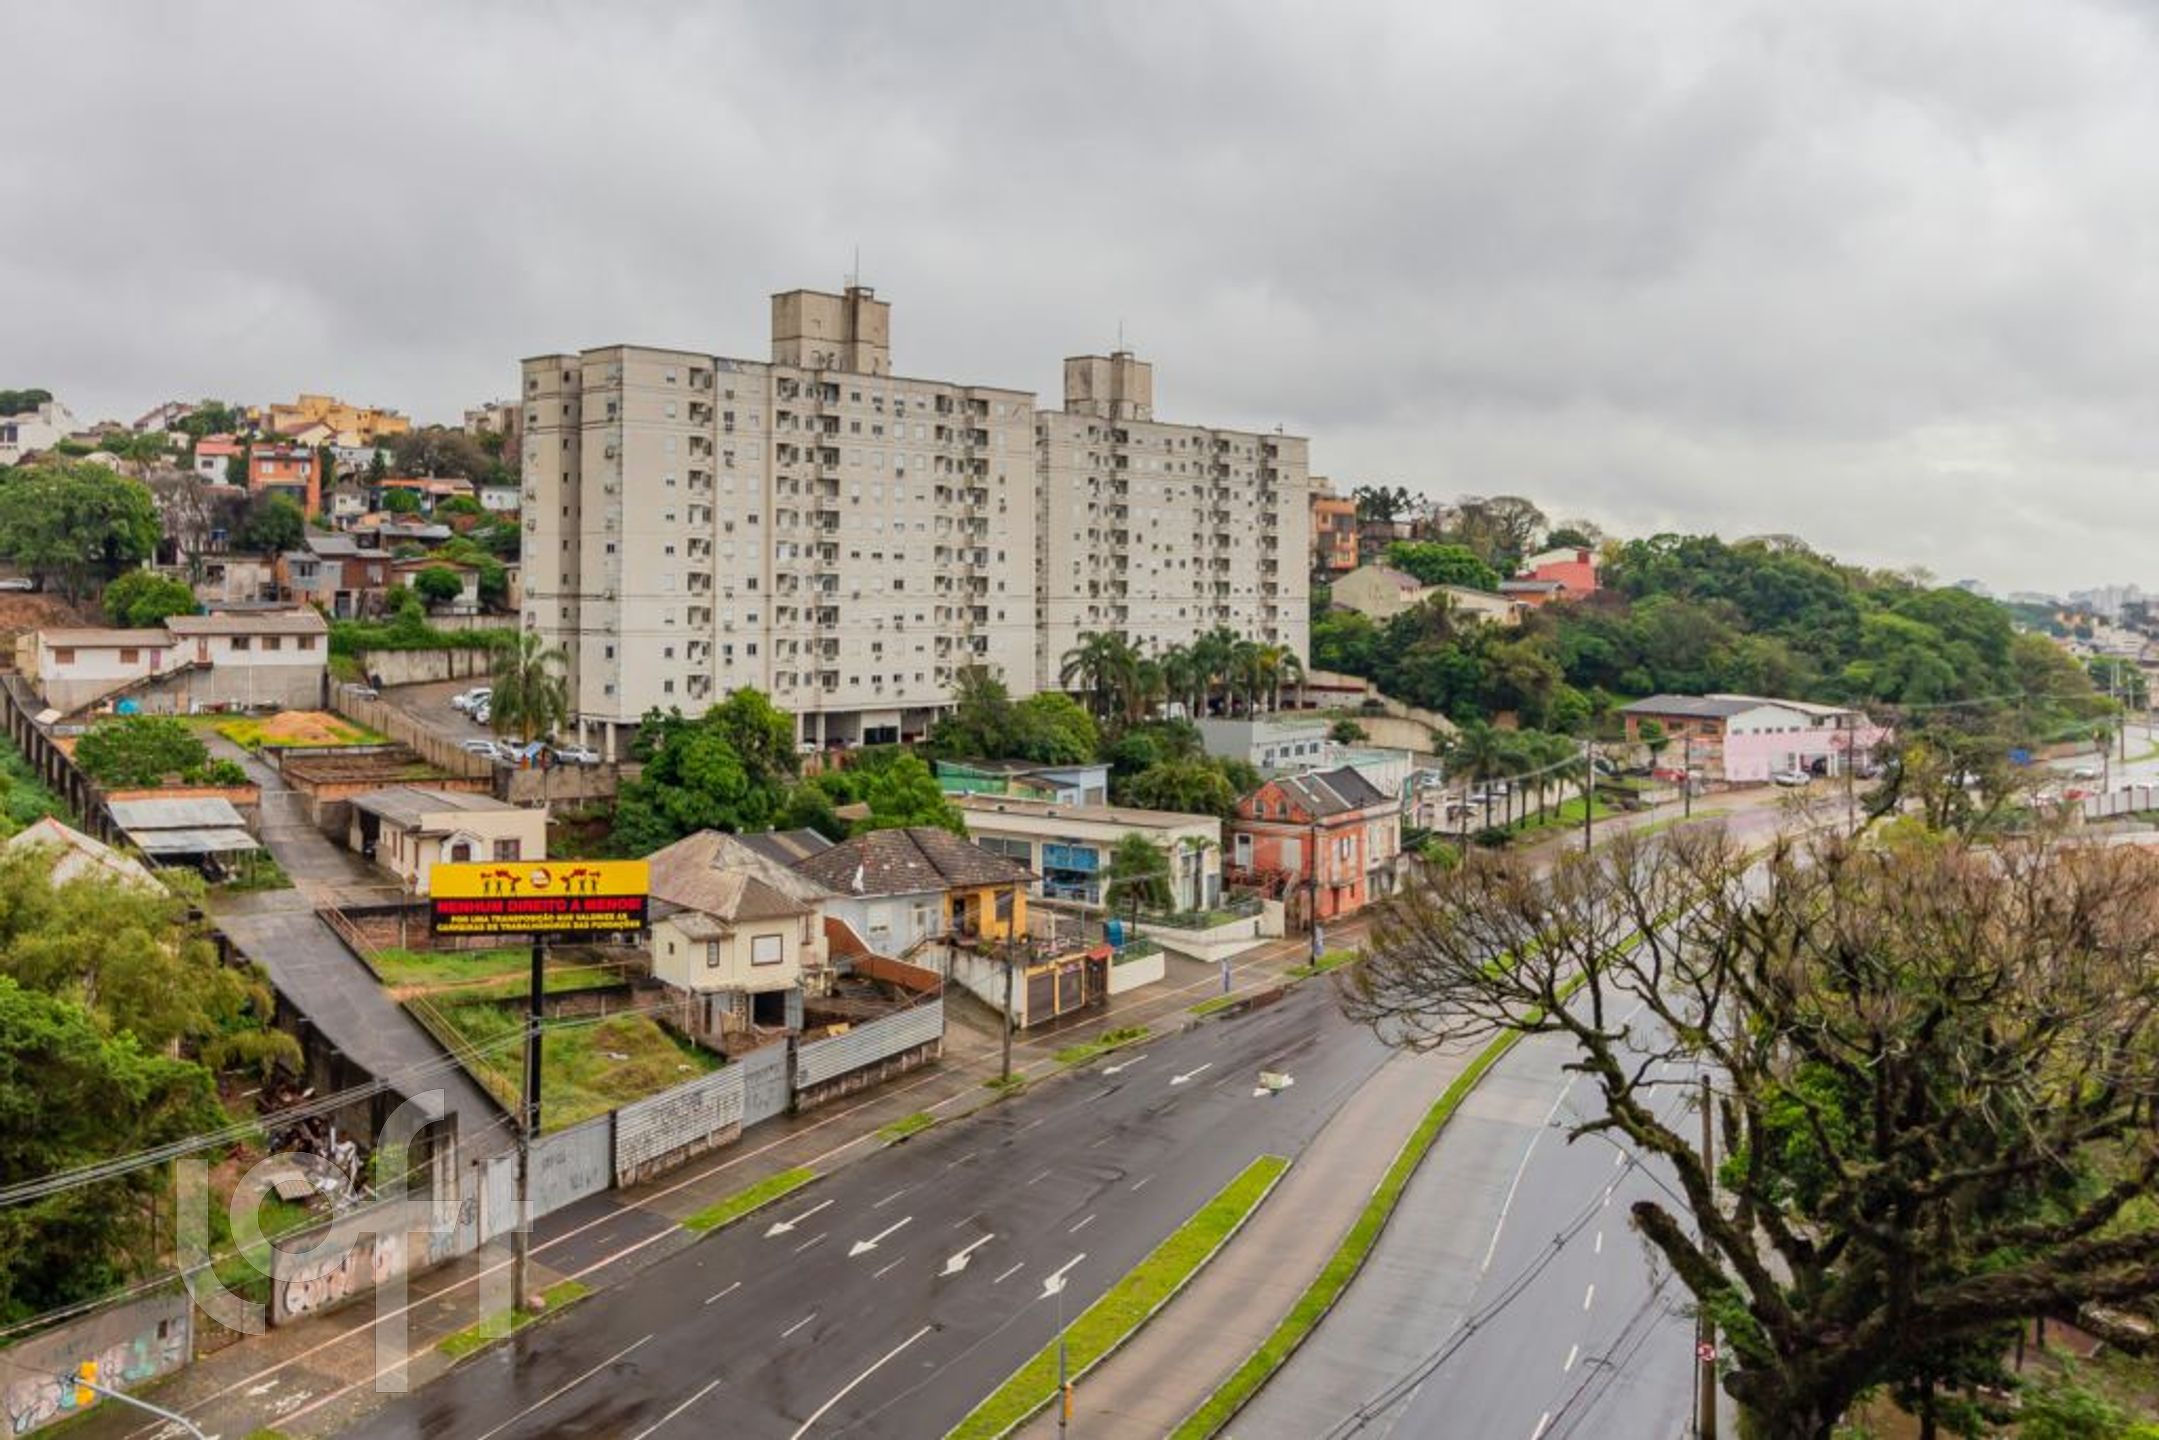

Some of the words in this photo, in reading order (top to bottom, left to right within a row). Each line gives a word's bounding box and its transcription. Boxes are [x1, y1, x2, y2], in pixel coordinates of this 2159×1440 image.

[437, 901, 504, 913] NENHUM
[507, 900, 567, 912] DIREITO
[569, 899, 582, 912] A
